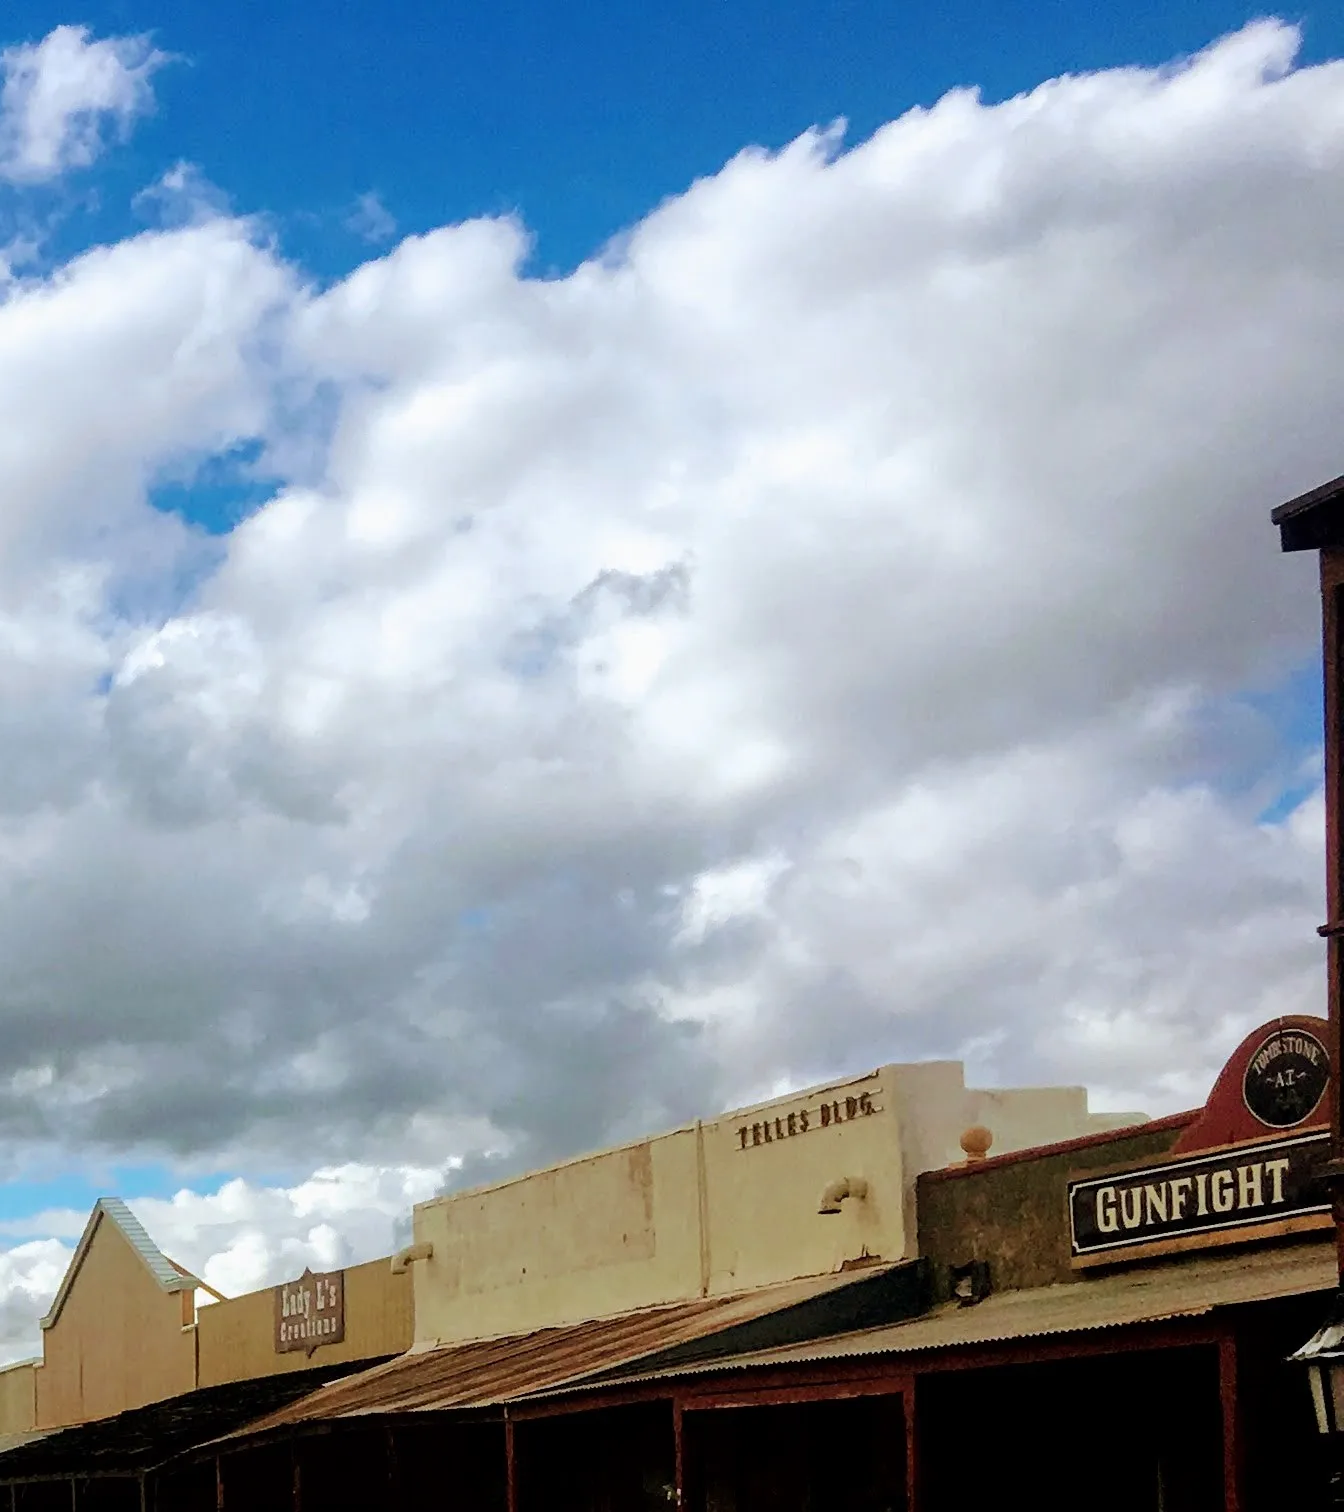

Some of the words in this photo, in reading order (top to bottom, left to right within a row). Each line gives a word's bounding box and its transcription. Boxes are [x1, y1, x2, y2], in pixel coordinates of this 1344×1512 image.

[1252, 1036, 1321, 1075] TOMBSTONE
[738, 1109, 810, 1149] TELLES
[1095, 1157, 1290, 1234] GUNFIGHT
[282, 1284, 311, 1319] Lady
[280, 1316, 337, 1342] Creations
